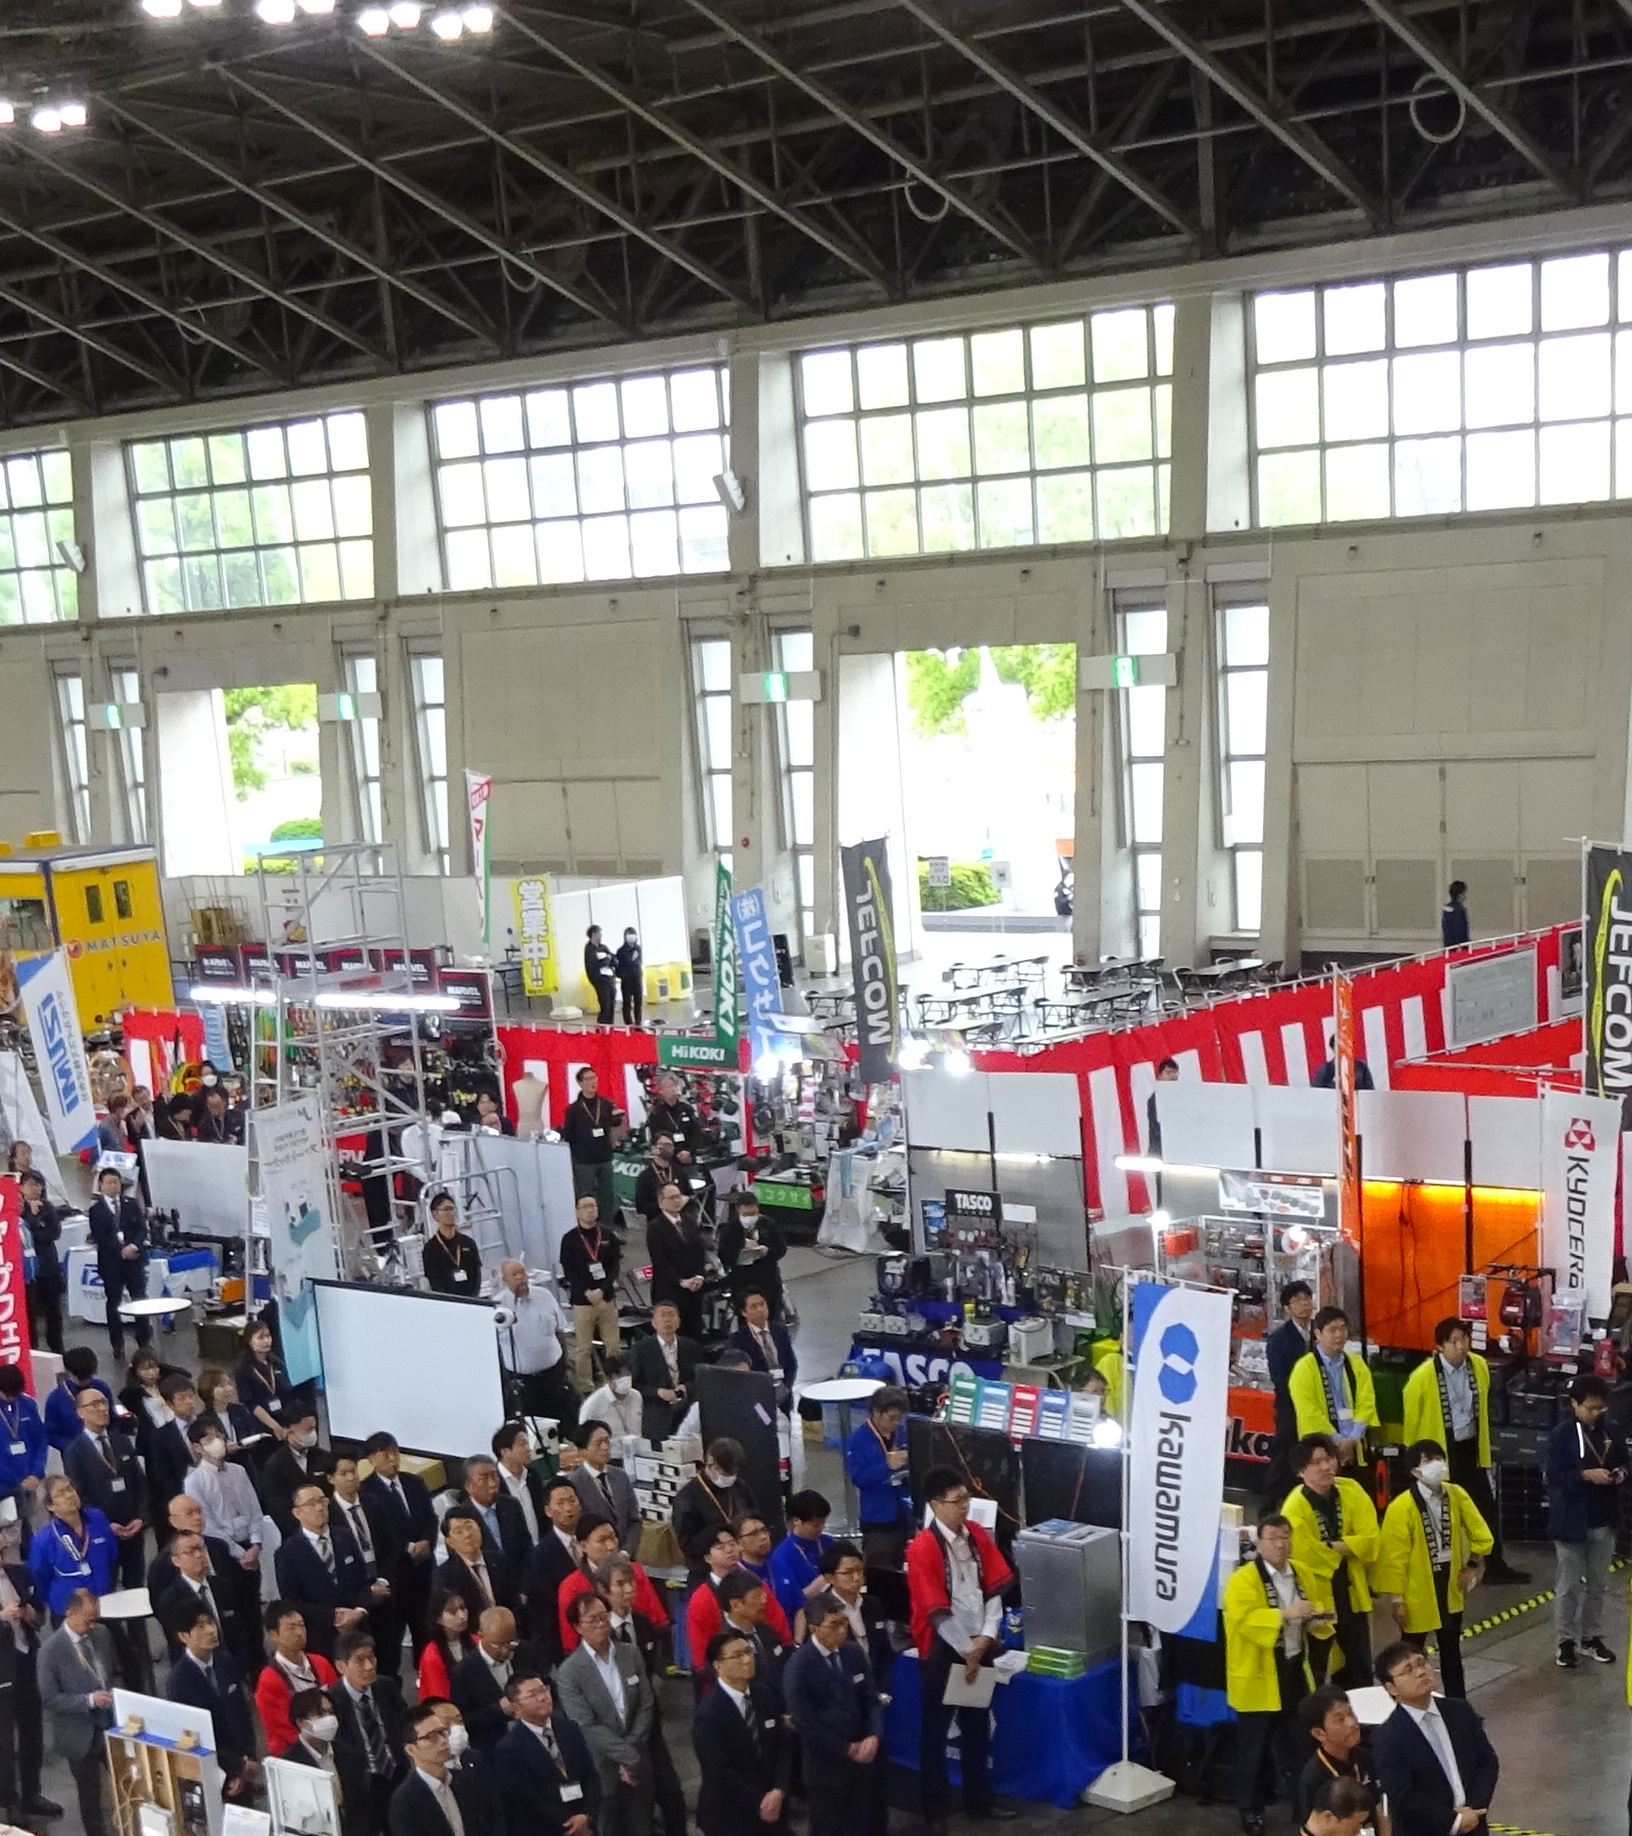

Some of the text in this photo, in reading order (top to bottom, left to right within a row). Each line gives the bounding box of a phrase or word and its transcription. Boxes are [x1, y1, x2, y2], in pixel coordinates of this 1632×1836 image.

[87, 930, 161, 951] MATSUYA
[671, 1045, 726, 1061] HiKOKI
[954, 1193, 992, 1210] TASCO
[1567, 1155, 1590, 1290] KYOCERA
[1154, 1410, 1193, 1603] kawamura
